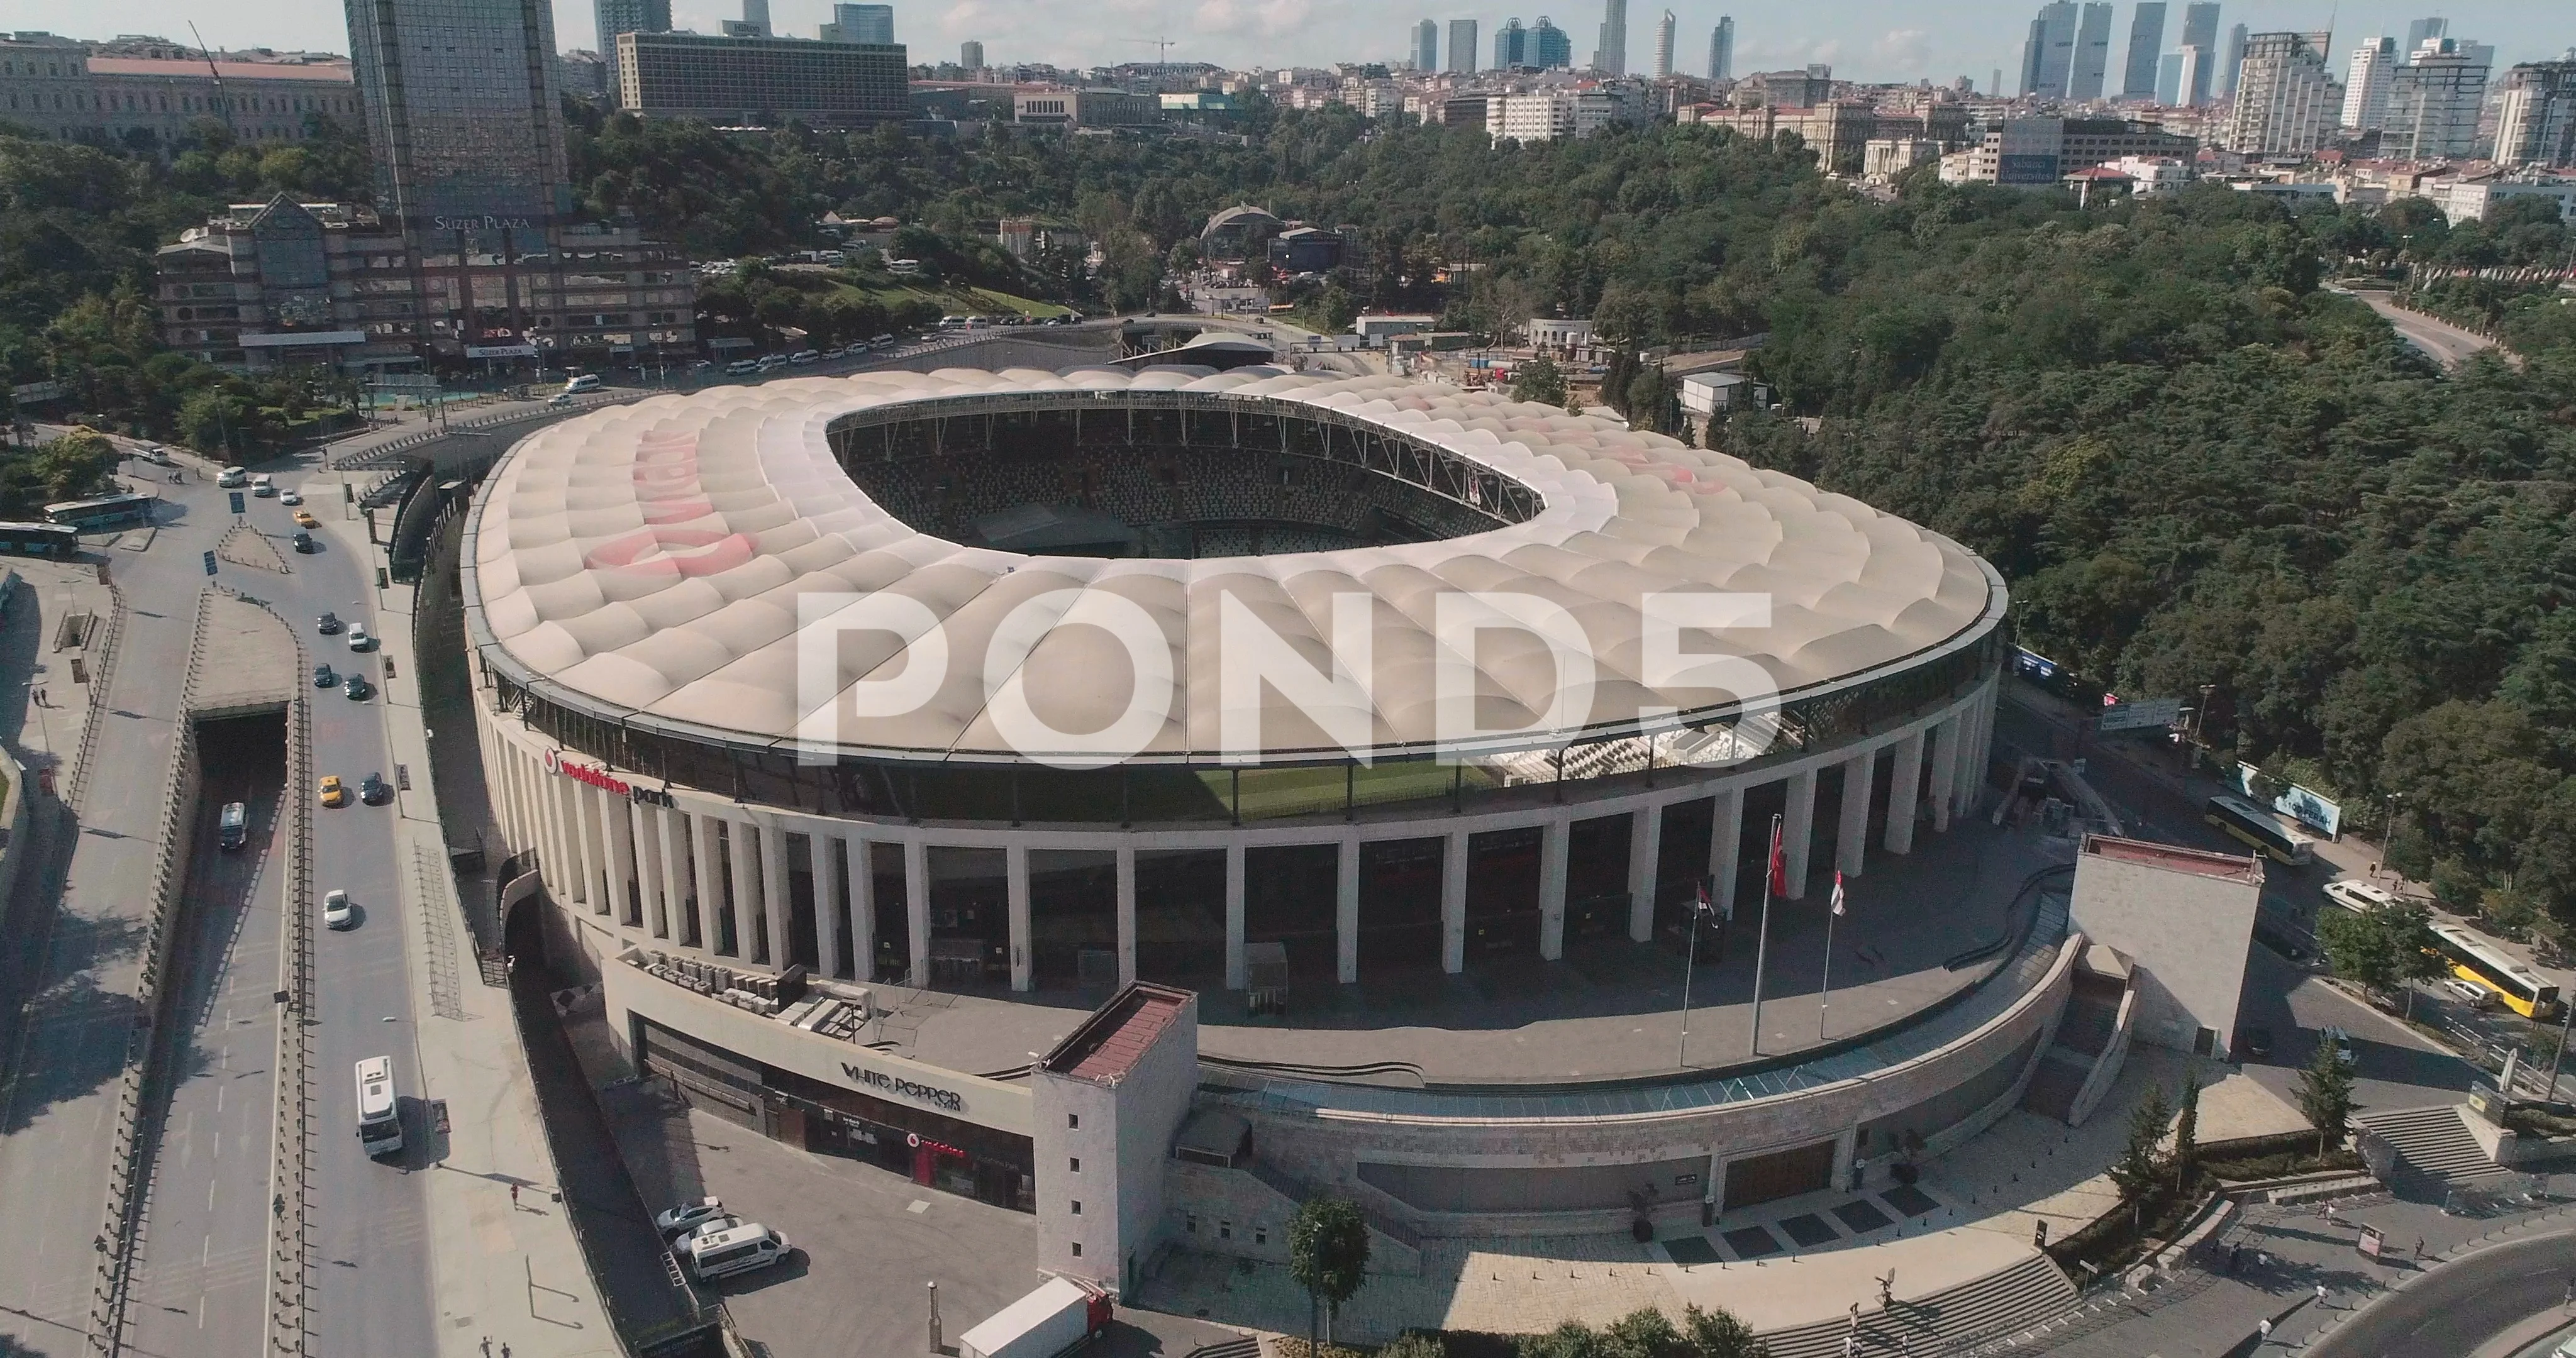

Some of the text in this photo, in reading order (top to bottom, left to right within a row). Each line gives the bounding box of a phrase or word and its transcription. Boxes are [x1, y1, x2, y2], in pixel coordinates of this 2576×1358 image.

[734, 23, 760, 33] Hilton
[484, 216, 530, 229] PLAZA
[561, 760, 675, 809] vodafone park
